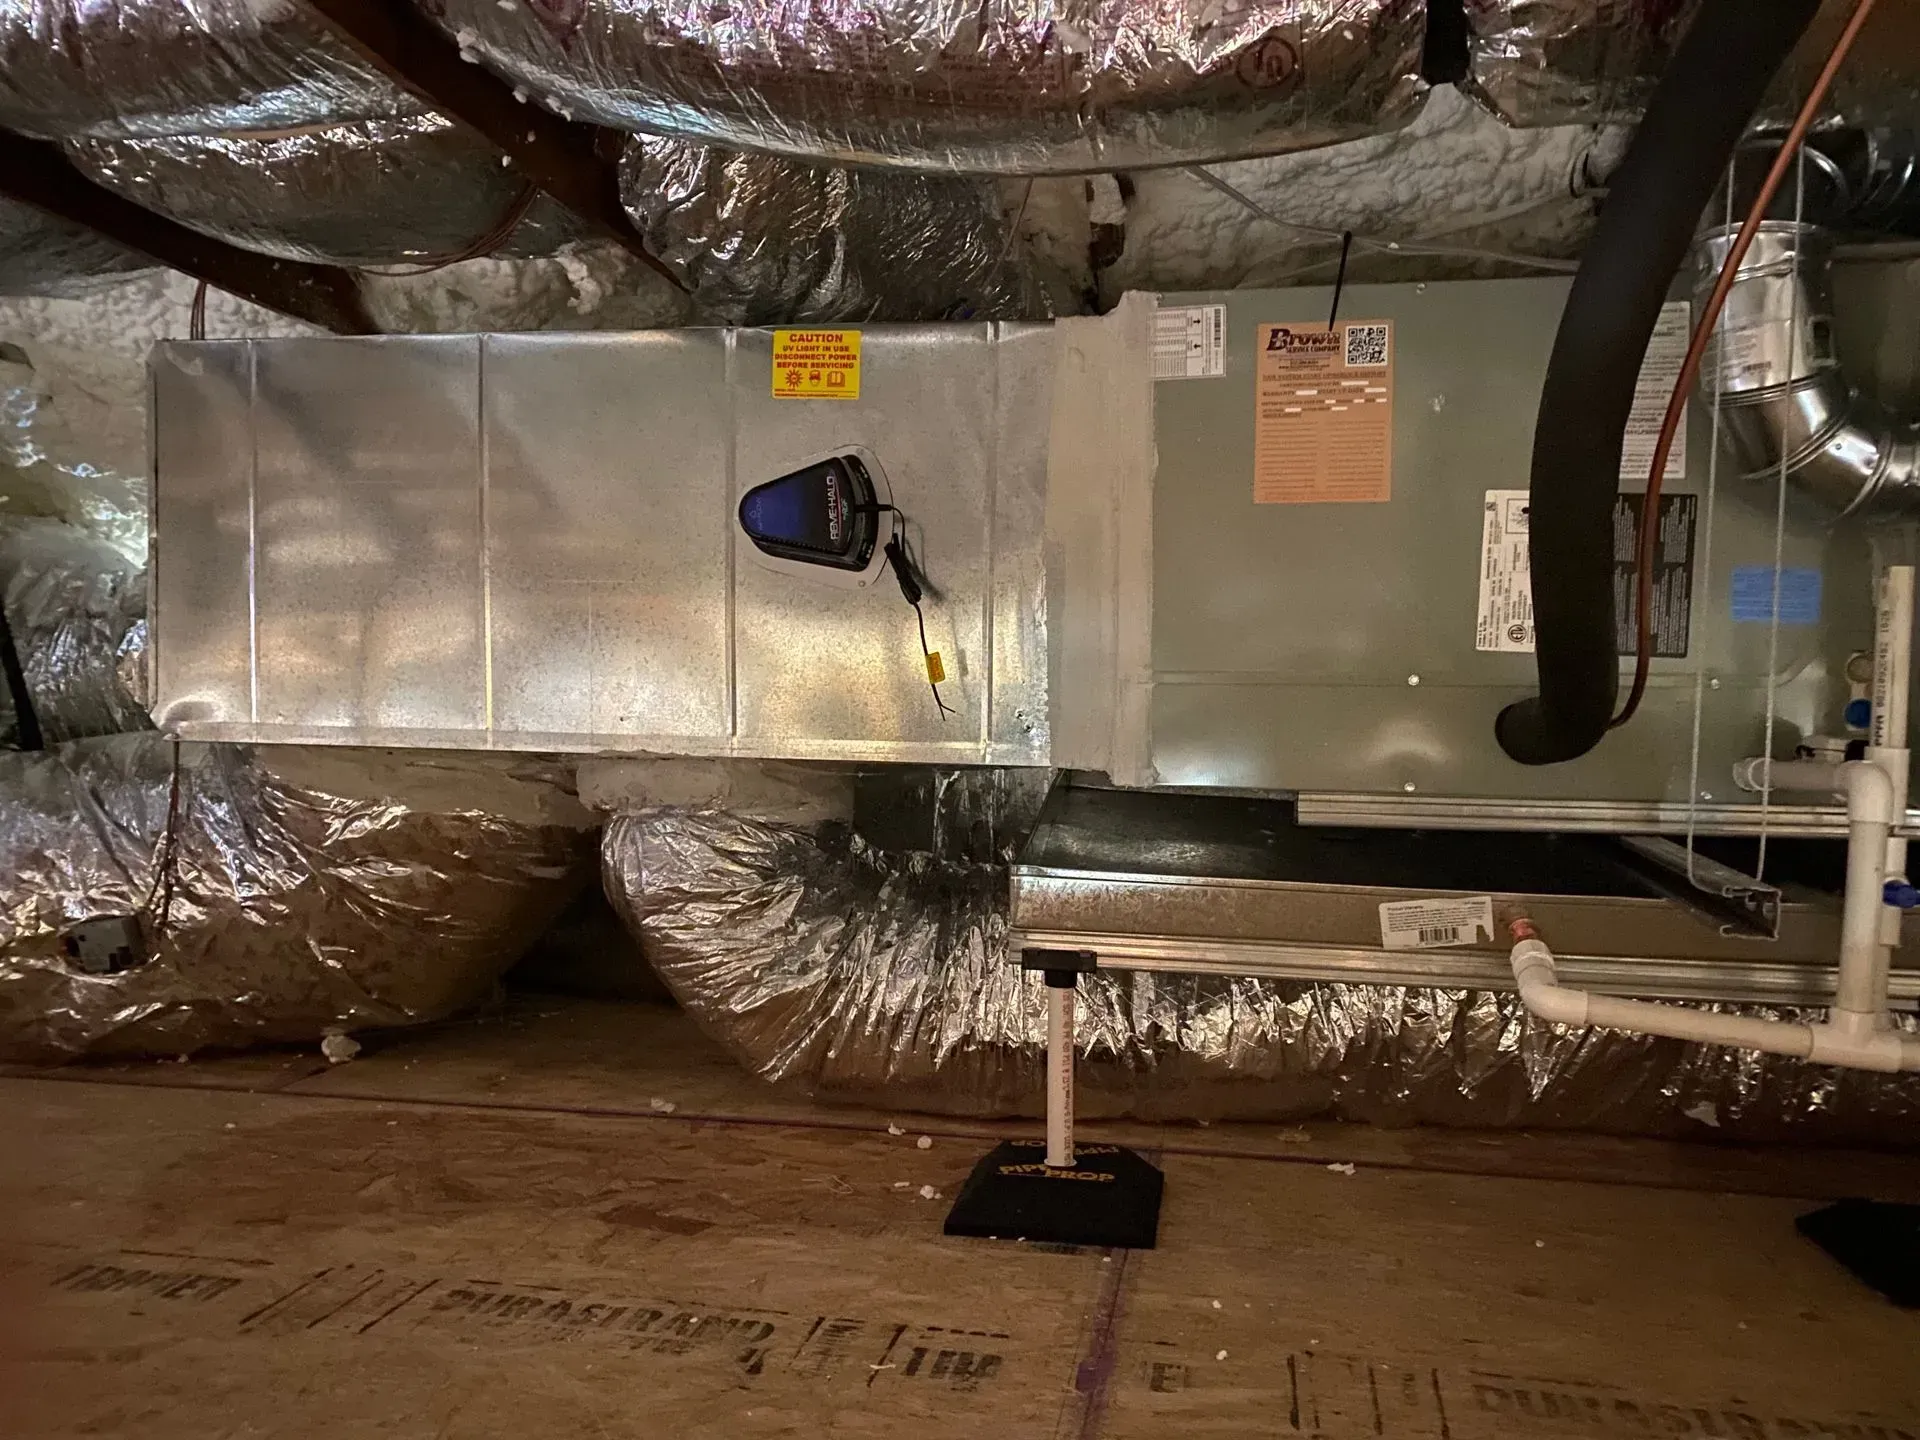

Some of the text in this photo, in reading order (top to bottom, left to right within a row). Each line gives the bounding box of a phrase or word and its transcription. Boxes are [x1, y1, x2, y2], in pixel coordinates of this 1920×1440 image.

[789, 333, 844, 343] CAUTION
[1266, 328, 1341, 351] Brown
[1286, 344, 1341, 353] SERVICE COMPANY
[1044, 1168, 1116, 1182] PROP
[430, 1288, 777, 1344] DURASTRAND
